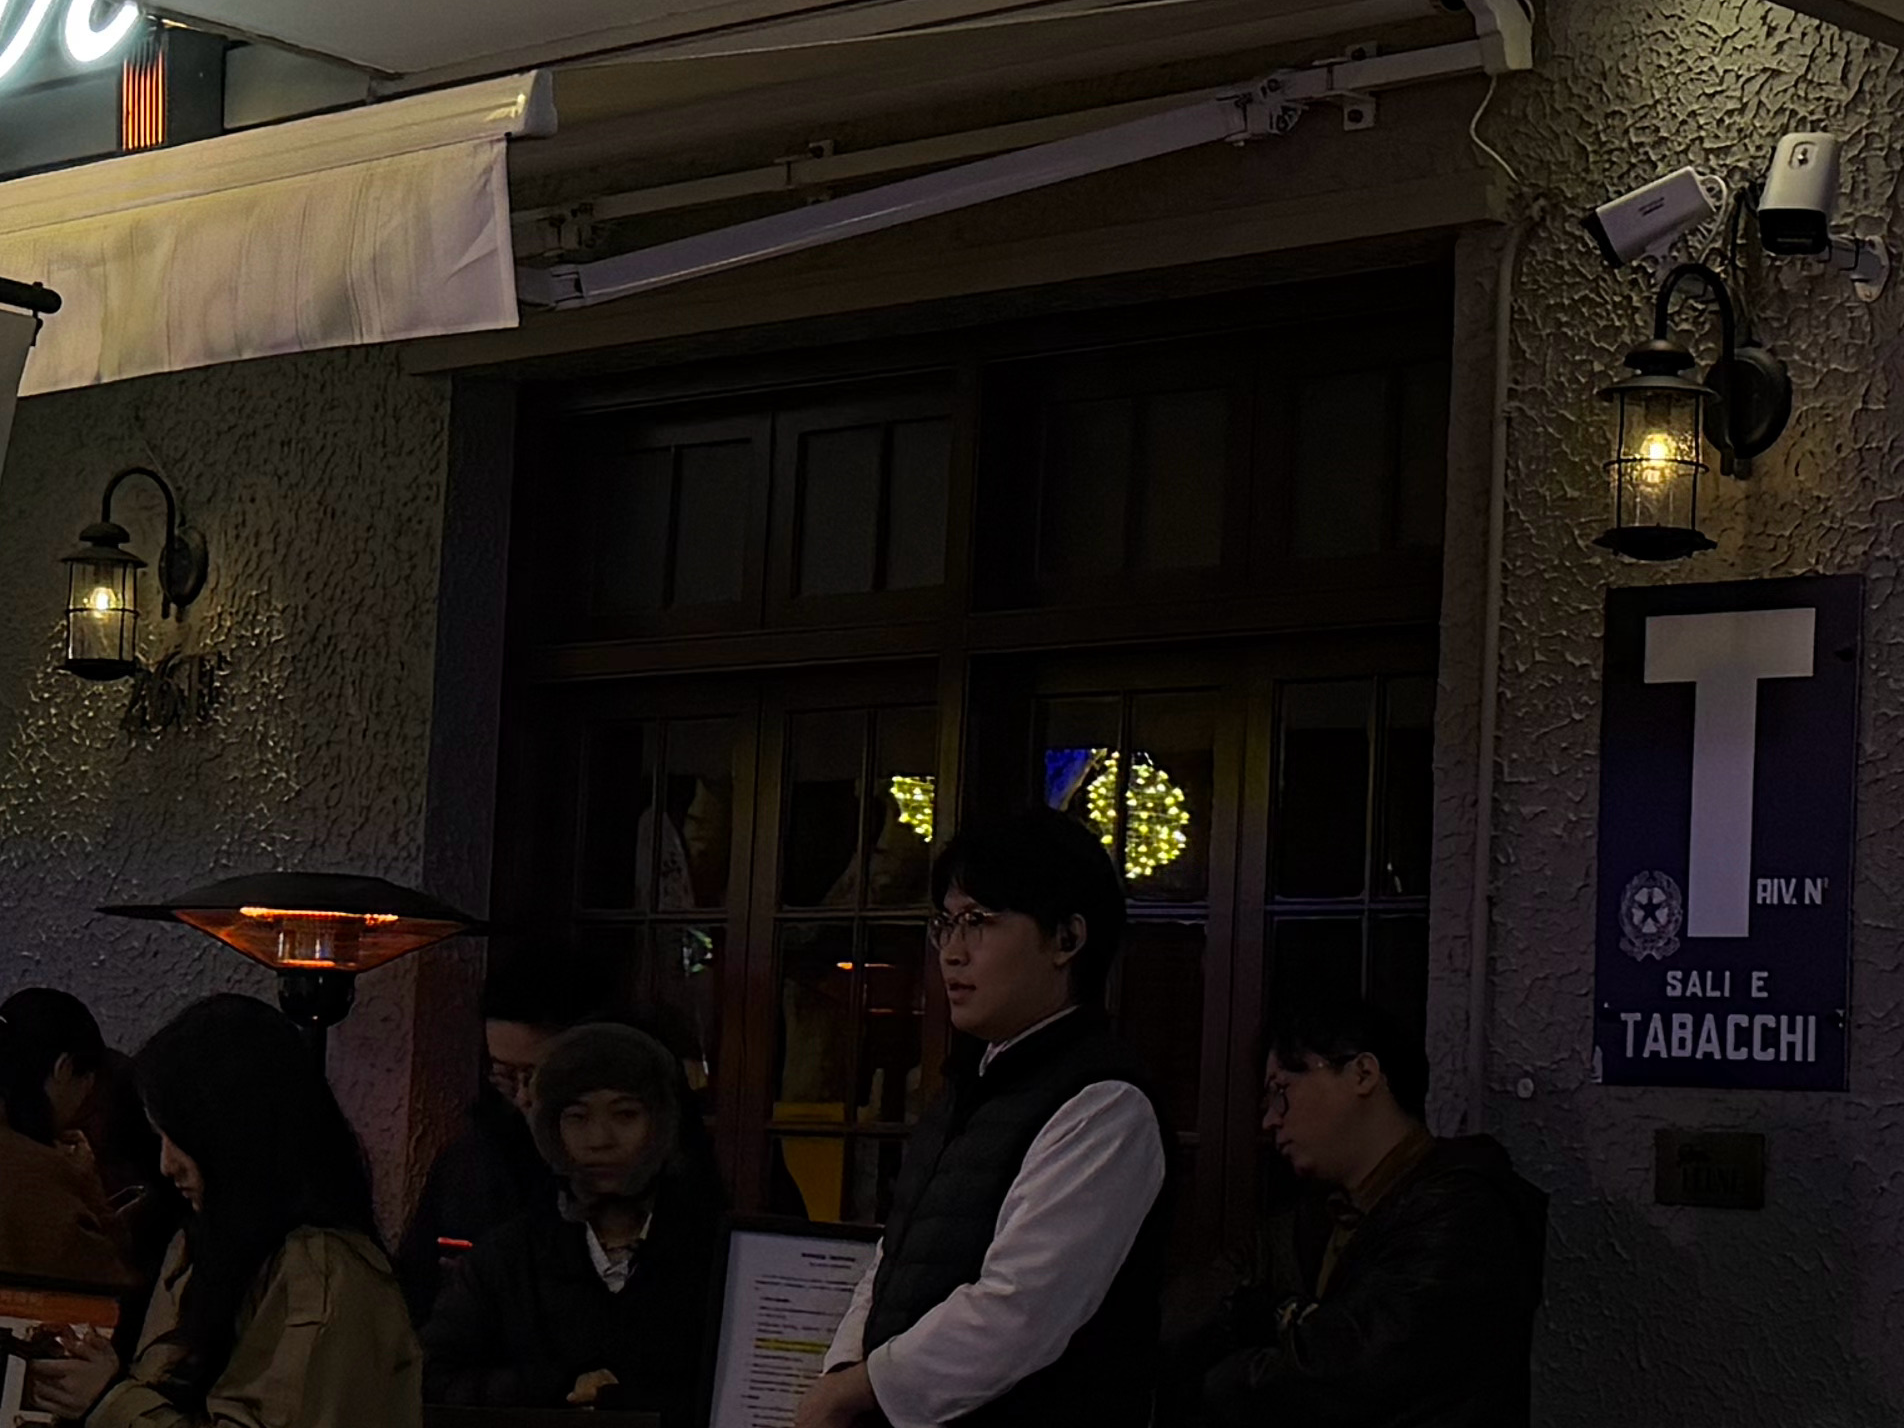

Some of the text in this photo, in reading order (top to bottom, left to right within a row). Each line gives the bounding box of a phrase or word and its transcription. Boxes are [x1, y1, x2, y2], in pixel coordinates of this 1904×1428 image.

[1644, 607, 1817, 939] T
[1665, 970, 1770, 998] SALI E
[1620, 1010, 1818, 1062] TABACCHI
